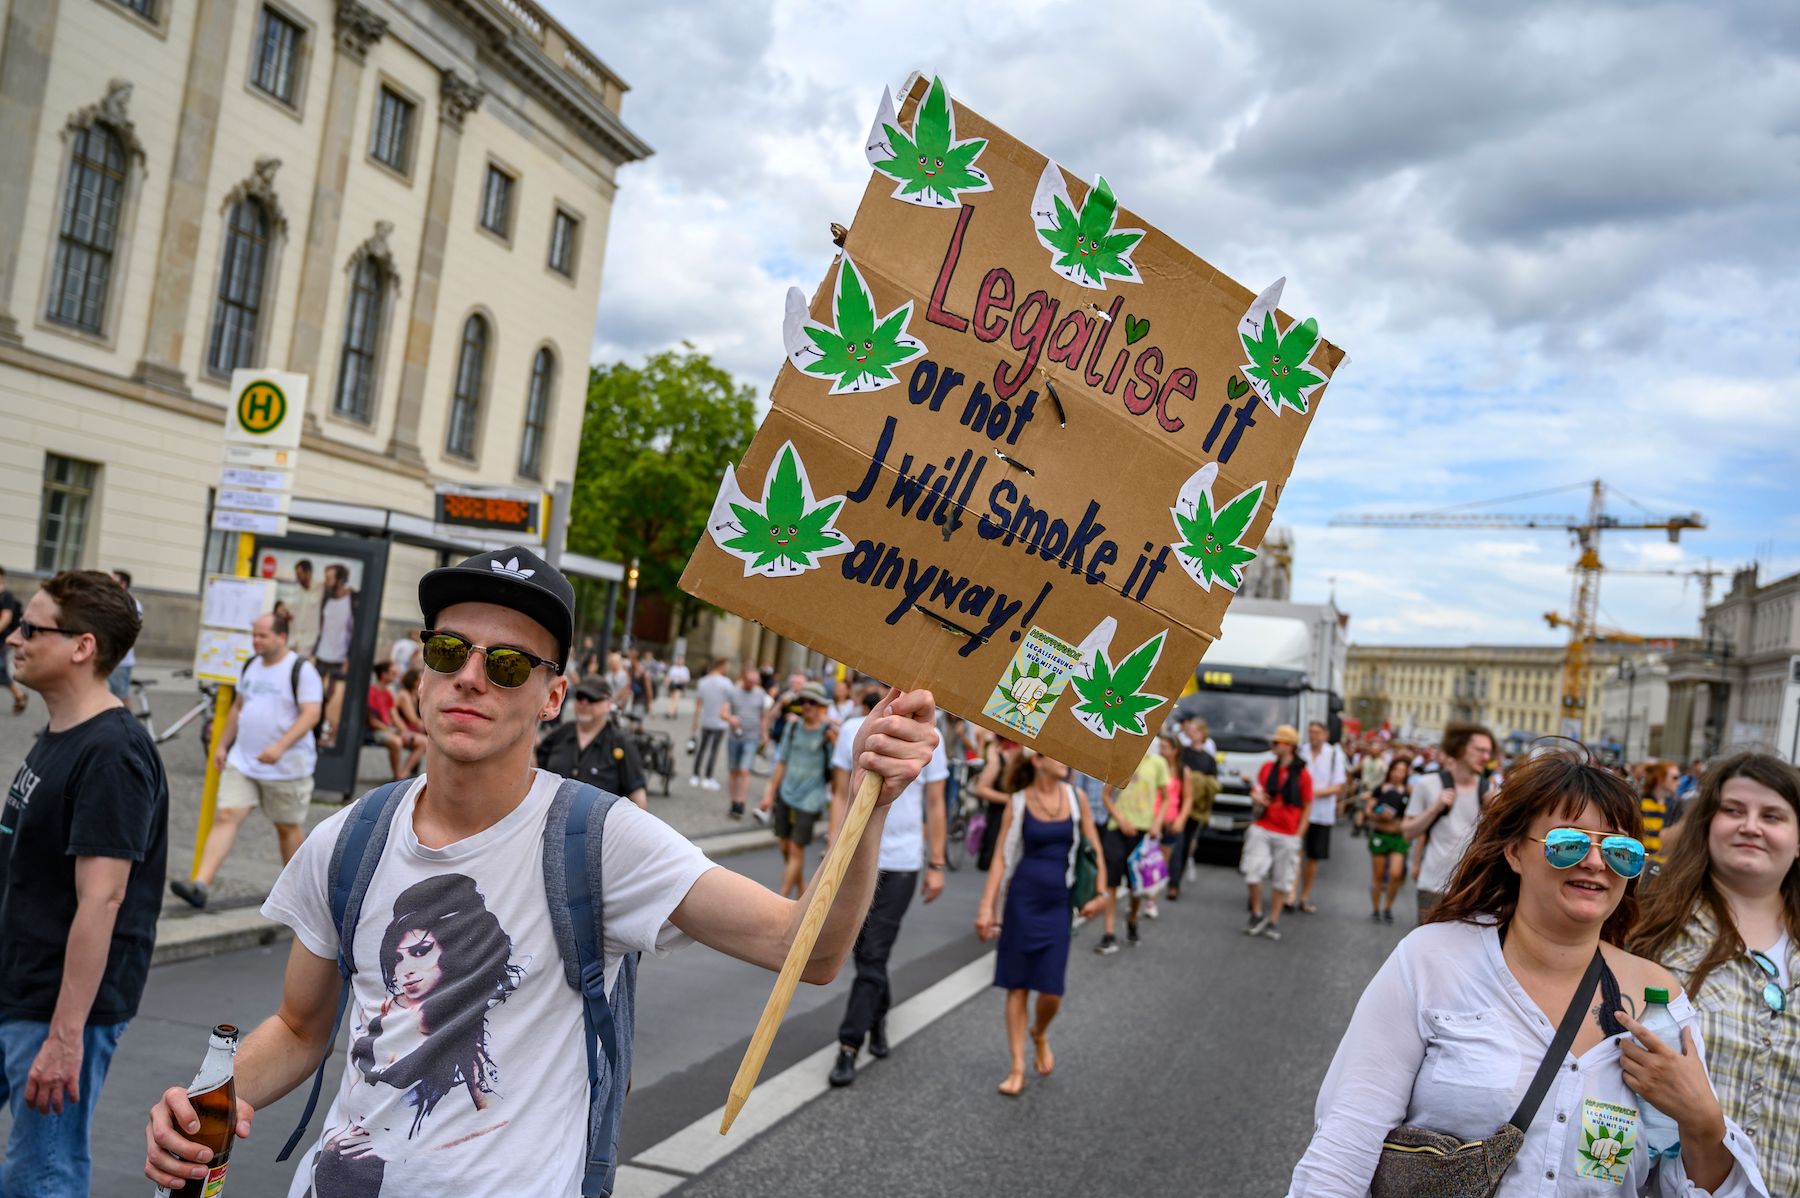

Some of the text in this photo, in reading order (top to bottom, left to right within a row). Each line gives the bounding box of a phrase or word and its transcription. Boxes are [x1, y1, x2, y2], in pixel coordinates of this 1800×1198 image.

[925, 204, 1261, 465] Legalise it
[249, 393, 272, 421] H
[908, 359, 1039, 445] or not
[886, 448, 988, 538] will
[1119, 541, 1173, 602] it
[841, 539, 1053, 657] anyway!
[1025, 641, 1074, 670] LEGALISIERUNG
[1026, 653, 1064, 675] NUR MIT DIR
